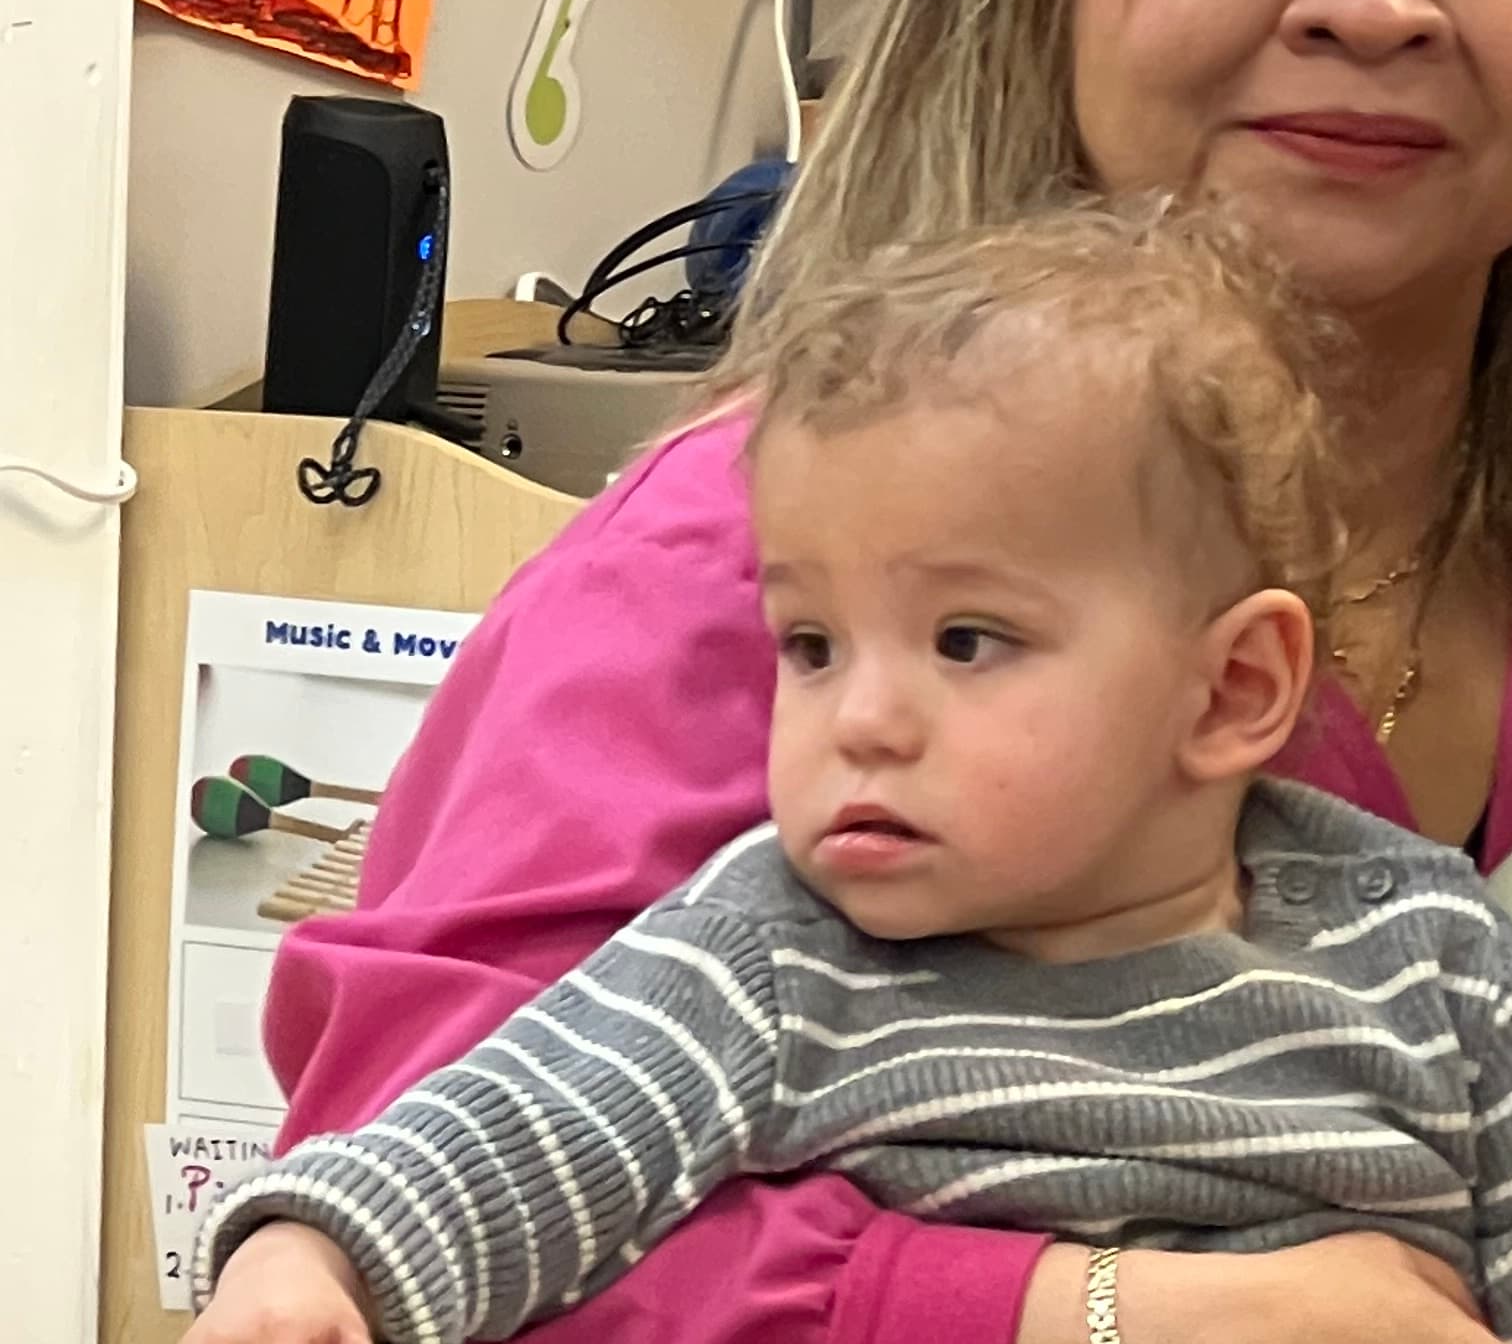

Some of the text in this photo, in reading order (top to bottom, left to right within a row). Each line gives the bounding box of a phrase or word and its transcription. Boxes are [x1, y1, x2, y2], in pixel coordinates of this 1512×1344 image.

[265, 620, 464, 659] Music & Mov
